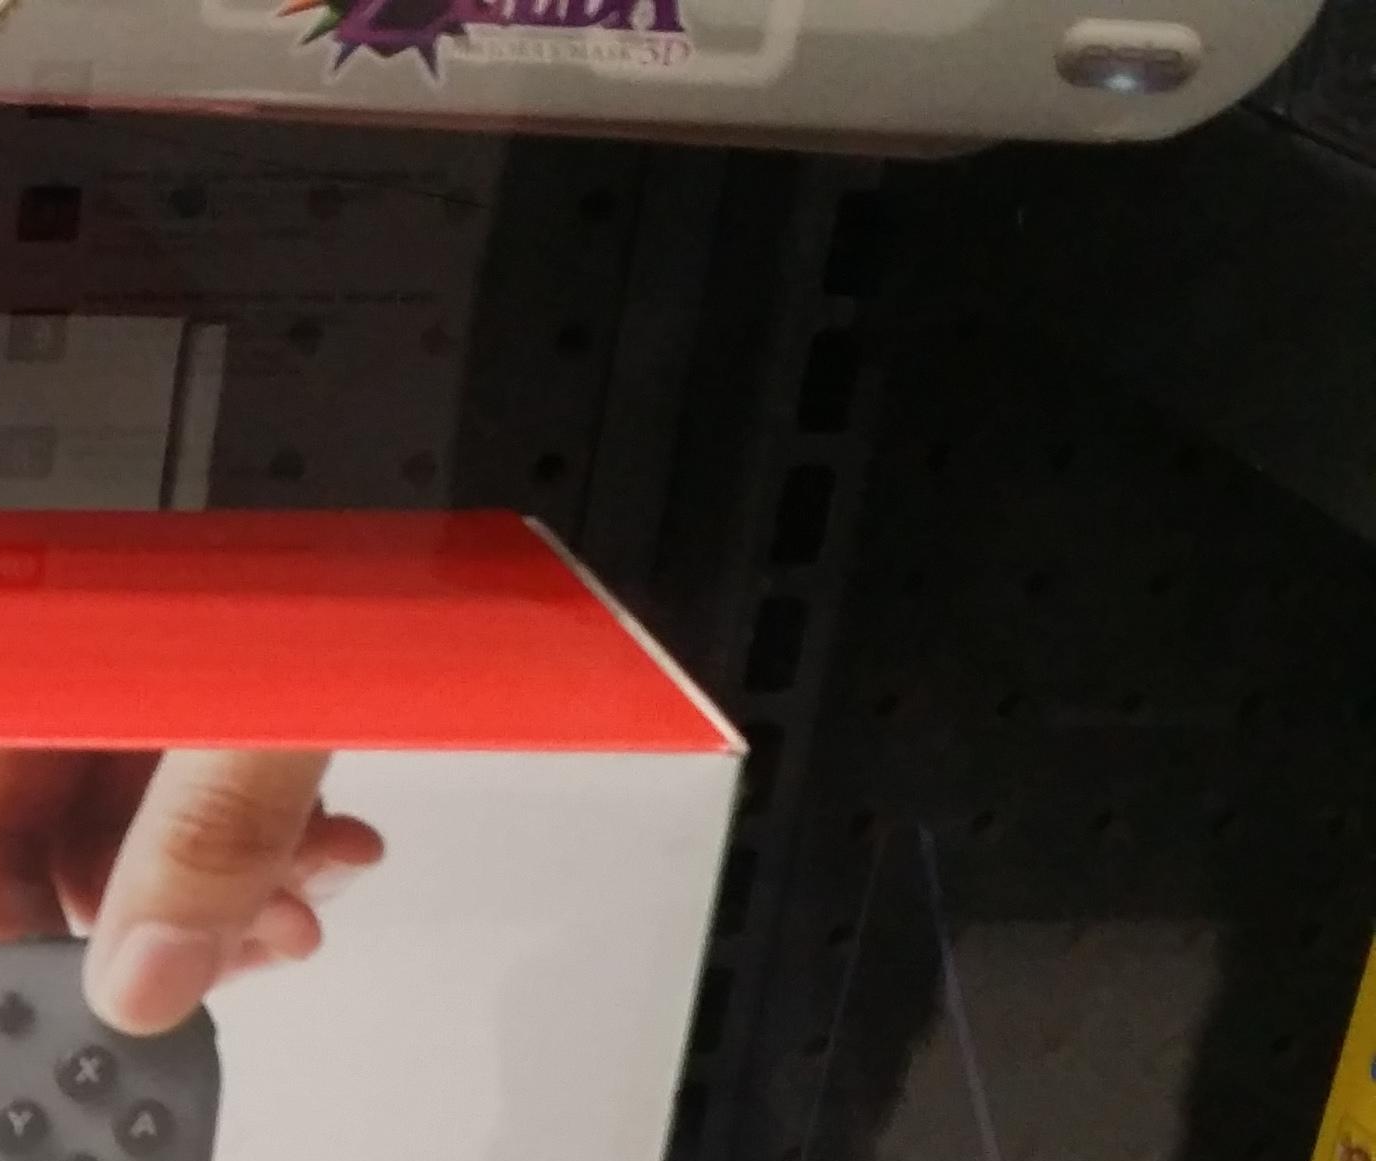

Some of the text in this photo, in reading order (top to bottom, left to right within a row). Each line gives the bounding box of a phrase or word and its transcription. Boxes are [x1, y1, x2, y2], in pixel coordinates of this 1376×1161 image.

[74, 1056, 101, 1084] X
[7, 1110, 34, 1137] Y
[128, 1110, 158, 1139] A
